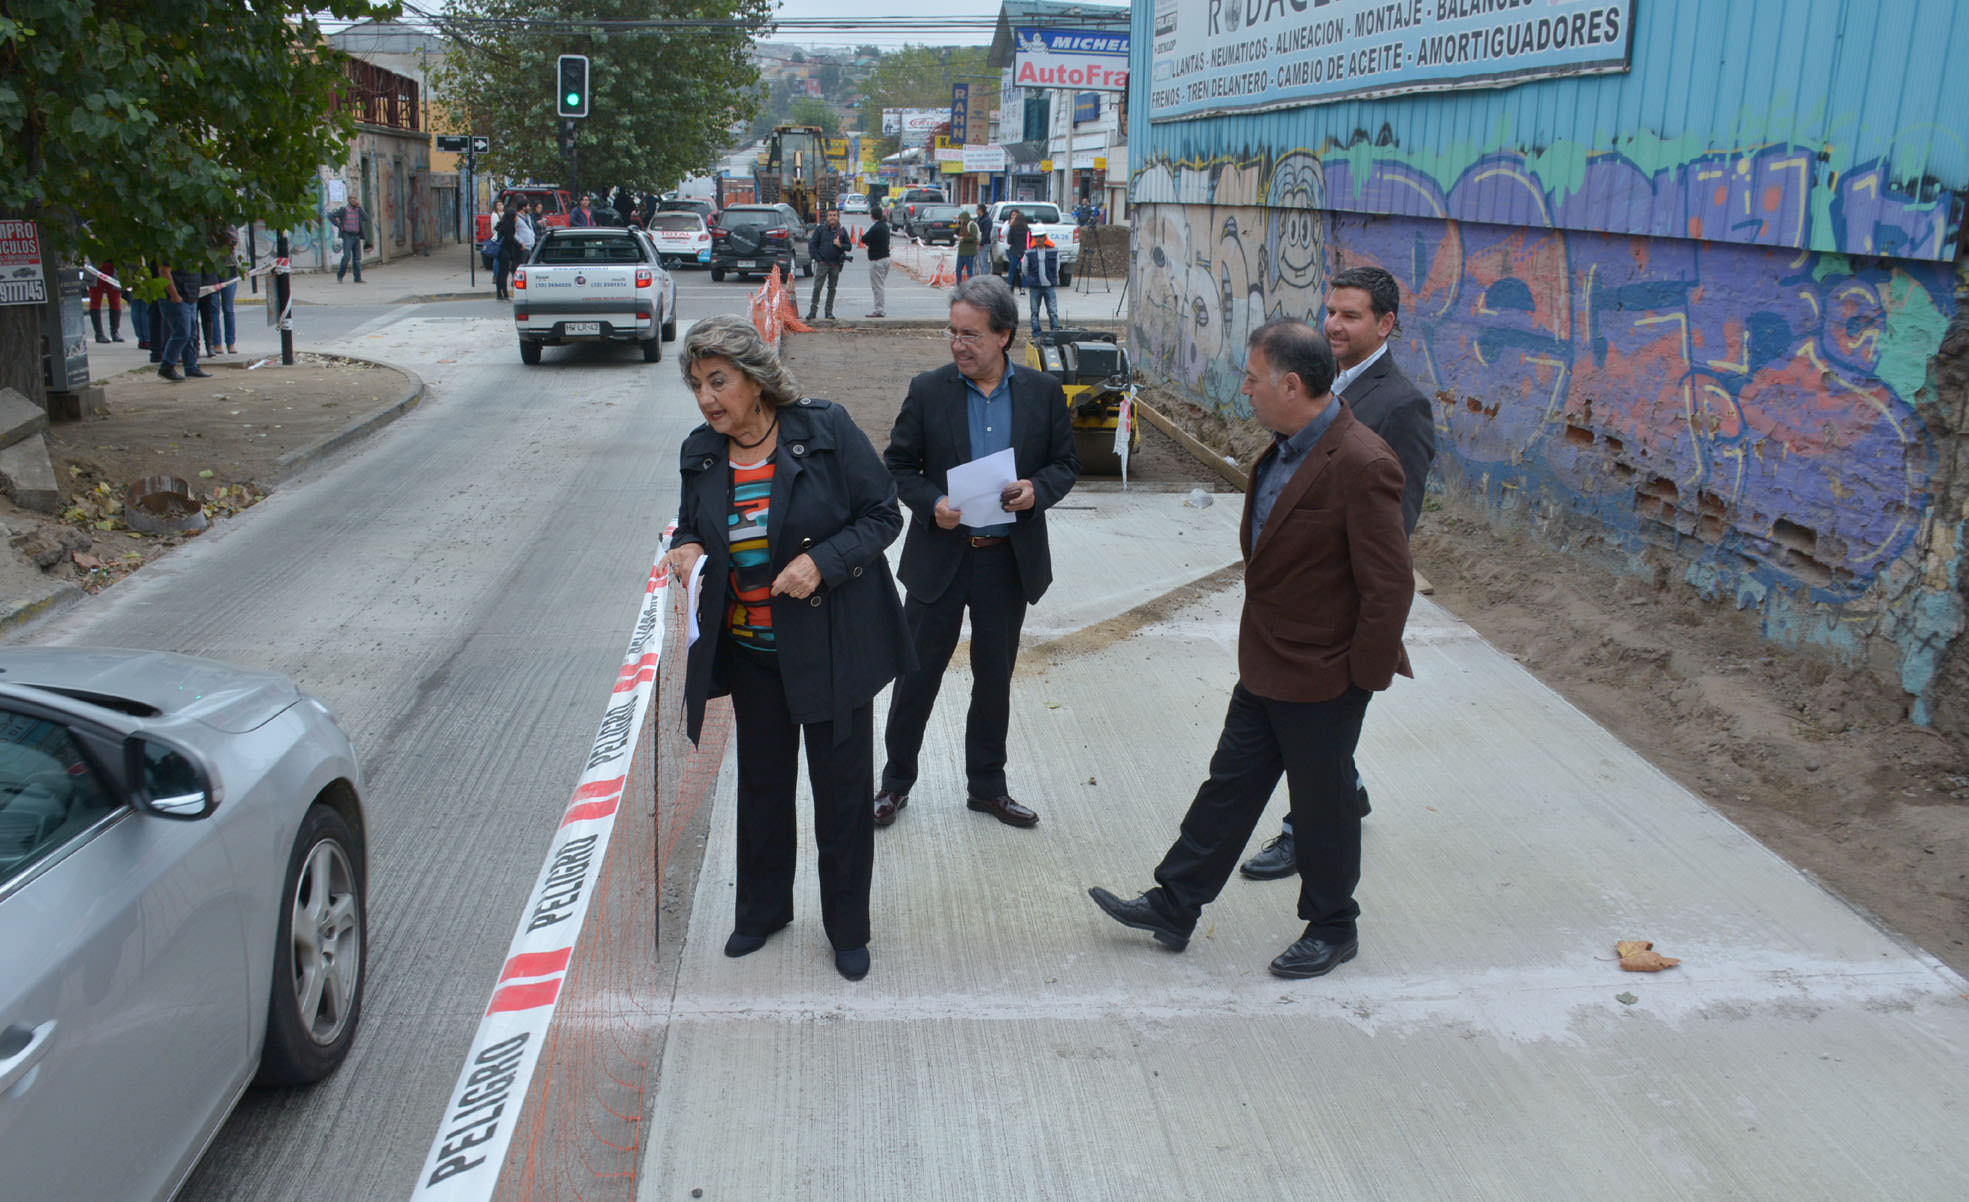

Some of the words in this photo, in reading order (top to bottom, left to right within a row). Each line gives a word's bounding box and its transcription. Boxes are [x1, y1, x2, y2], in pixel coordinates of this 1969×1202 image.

[1152, 87, 1180, 110] FRENOS
[1187, 79, 1209, 103] TREN
[1211, 70, 1268, 97] DELANTERO
[1277, 59, 1323, 88] CAMBIO
[1327, 54, 1344, 81] DE
[1348, 43, 1403, 78] ACEITE
[1417, 7, 1620, 66] AMORTIGUADORES
[1172, 52, 1204, 78] LLANTAS
[1211, 37, 1268, 68] NEUMATICOS
[1275, 18, 1344, 55] ALINEACION
[1354, 0, 1422, 38] MONTAJE
[953, 88, 966, 138] RAHN
[586, 695, 639, 772] PELIGRO
[526, 834, 598, 935] PELIGRO
[426, 1032, 531, 1189] PELIGRO
